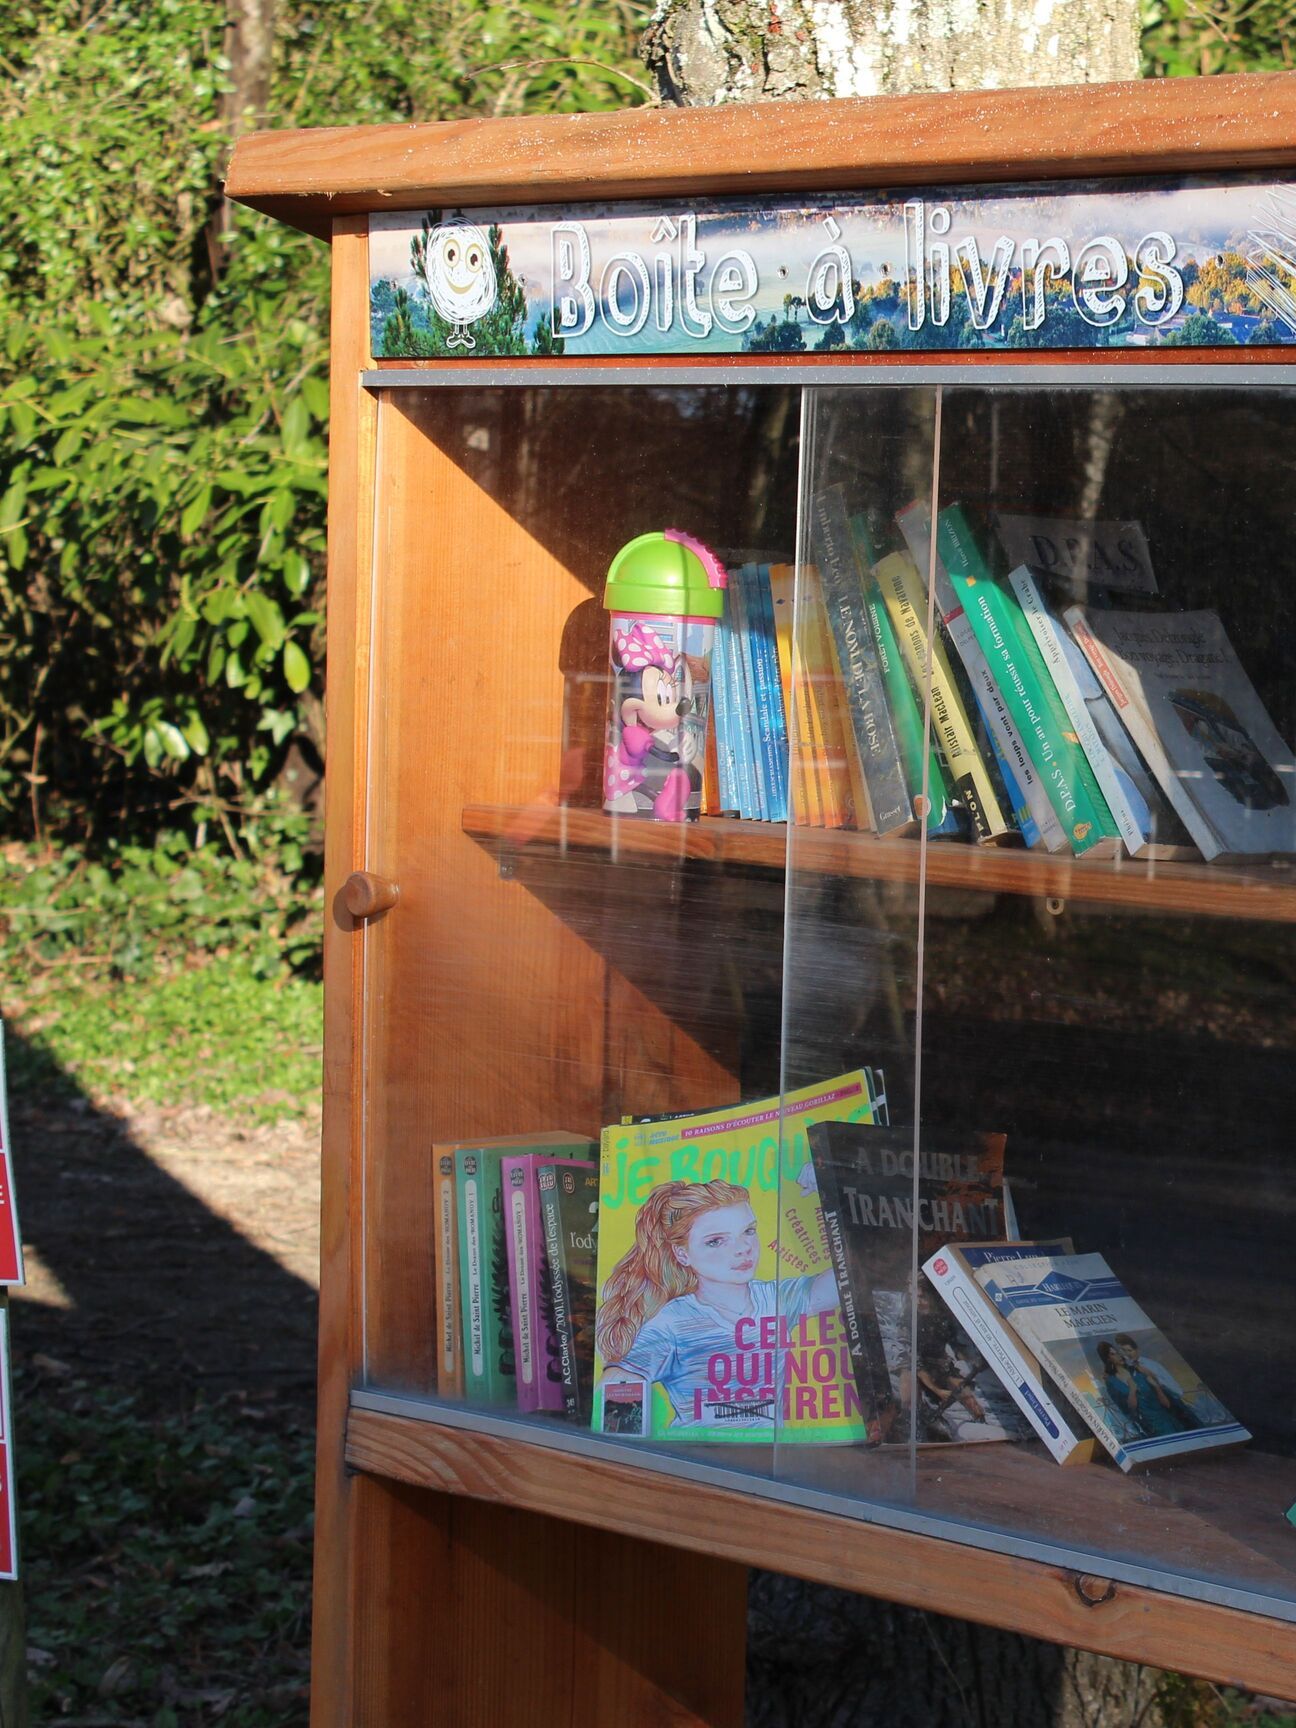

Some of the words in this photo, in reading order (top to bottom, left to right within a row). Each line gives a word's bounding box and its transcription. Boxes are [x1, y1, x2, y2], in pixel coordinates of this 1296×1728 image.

[551, 211, 758, 338] Boîte
[805, 217, 855, 325] à
[903, 197, 1183, 331] livres
[890, 575, 906, 610] Navarone
[903, 612, 915, 628] de
[977, 595, 1004, 650] formation
[1001, 646, 1011, 662] sa
[756, 658, 767, 690] passion
[843, 619, 860, 658] NOM
[863, 712, 882, 757] ROSE
[981, 669, 994, 693] deux
[1008, 661, 1030, 700] réussir
[760, 692, 766, 702] et
[992, 695, 1005, 713] par
[1022, 698, 1042, 725] pour
[760, 703, 771, 742] Scandale
[1001, 713, 1013, 737] vont
[1034, 726, 1046, 743] an
[1012, 740, 1026, 766] loups
[1040, 744, 1054, 762] Un
[1022, 768, 1033, 785] les
[965, 789, 983, 833] PLON
[685, 1127, 694, 1137] 10
[694, 1122, 724, 1136] RAISONS
[765, 1111, 774, 1121] LE
[775, 1103, 804, 1118] NUVEAU
[857, 1147, 875, 1176] A
[880, 1149, 984, 1183] DOUBLE
[843, 1186, 999, 1236] TRANCHANT
[785, 1207, 821, 1265] Créatrices
[824, 1211, 850, 1291] TRANCHANT
[767, 1239, 809, 1273] Artistes
[843, 1291, 860, 1341] DOUBLE
[1054, 1306, 1071, 1318] LE
[1070, 1303, 1109, 1316] MARIN
[1064, 1313, 1119, 1329] MAGICIEN
[852, 1342, 864, 1357] A
[707, 1351, 773, 1395] QUI
[784, 1347, 854, 1384] NOU
